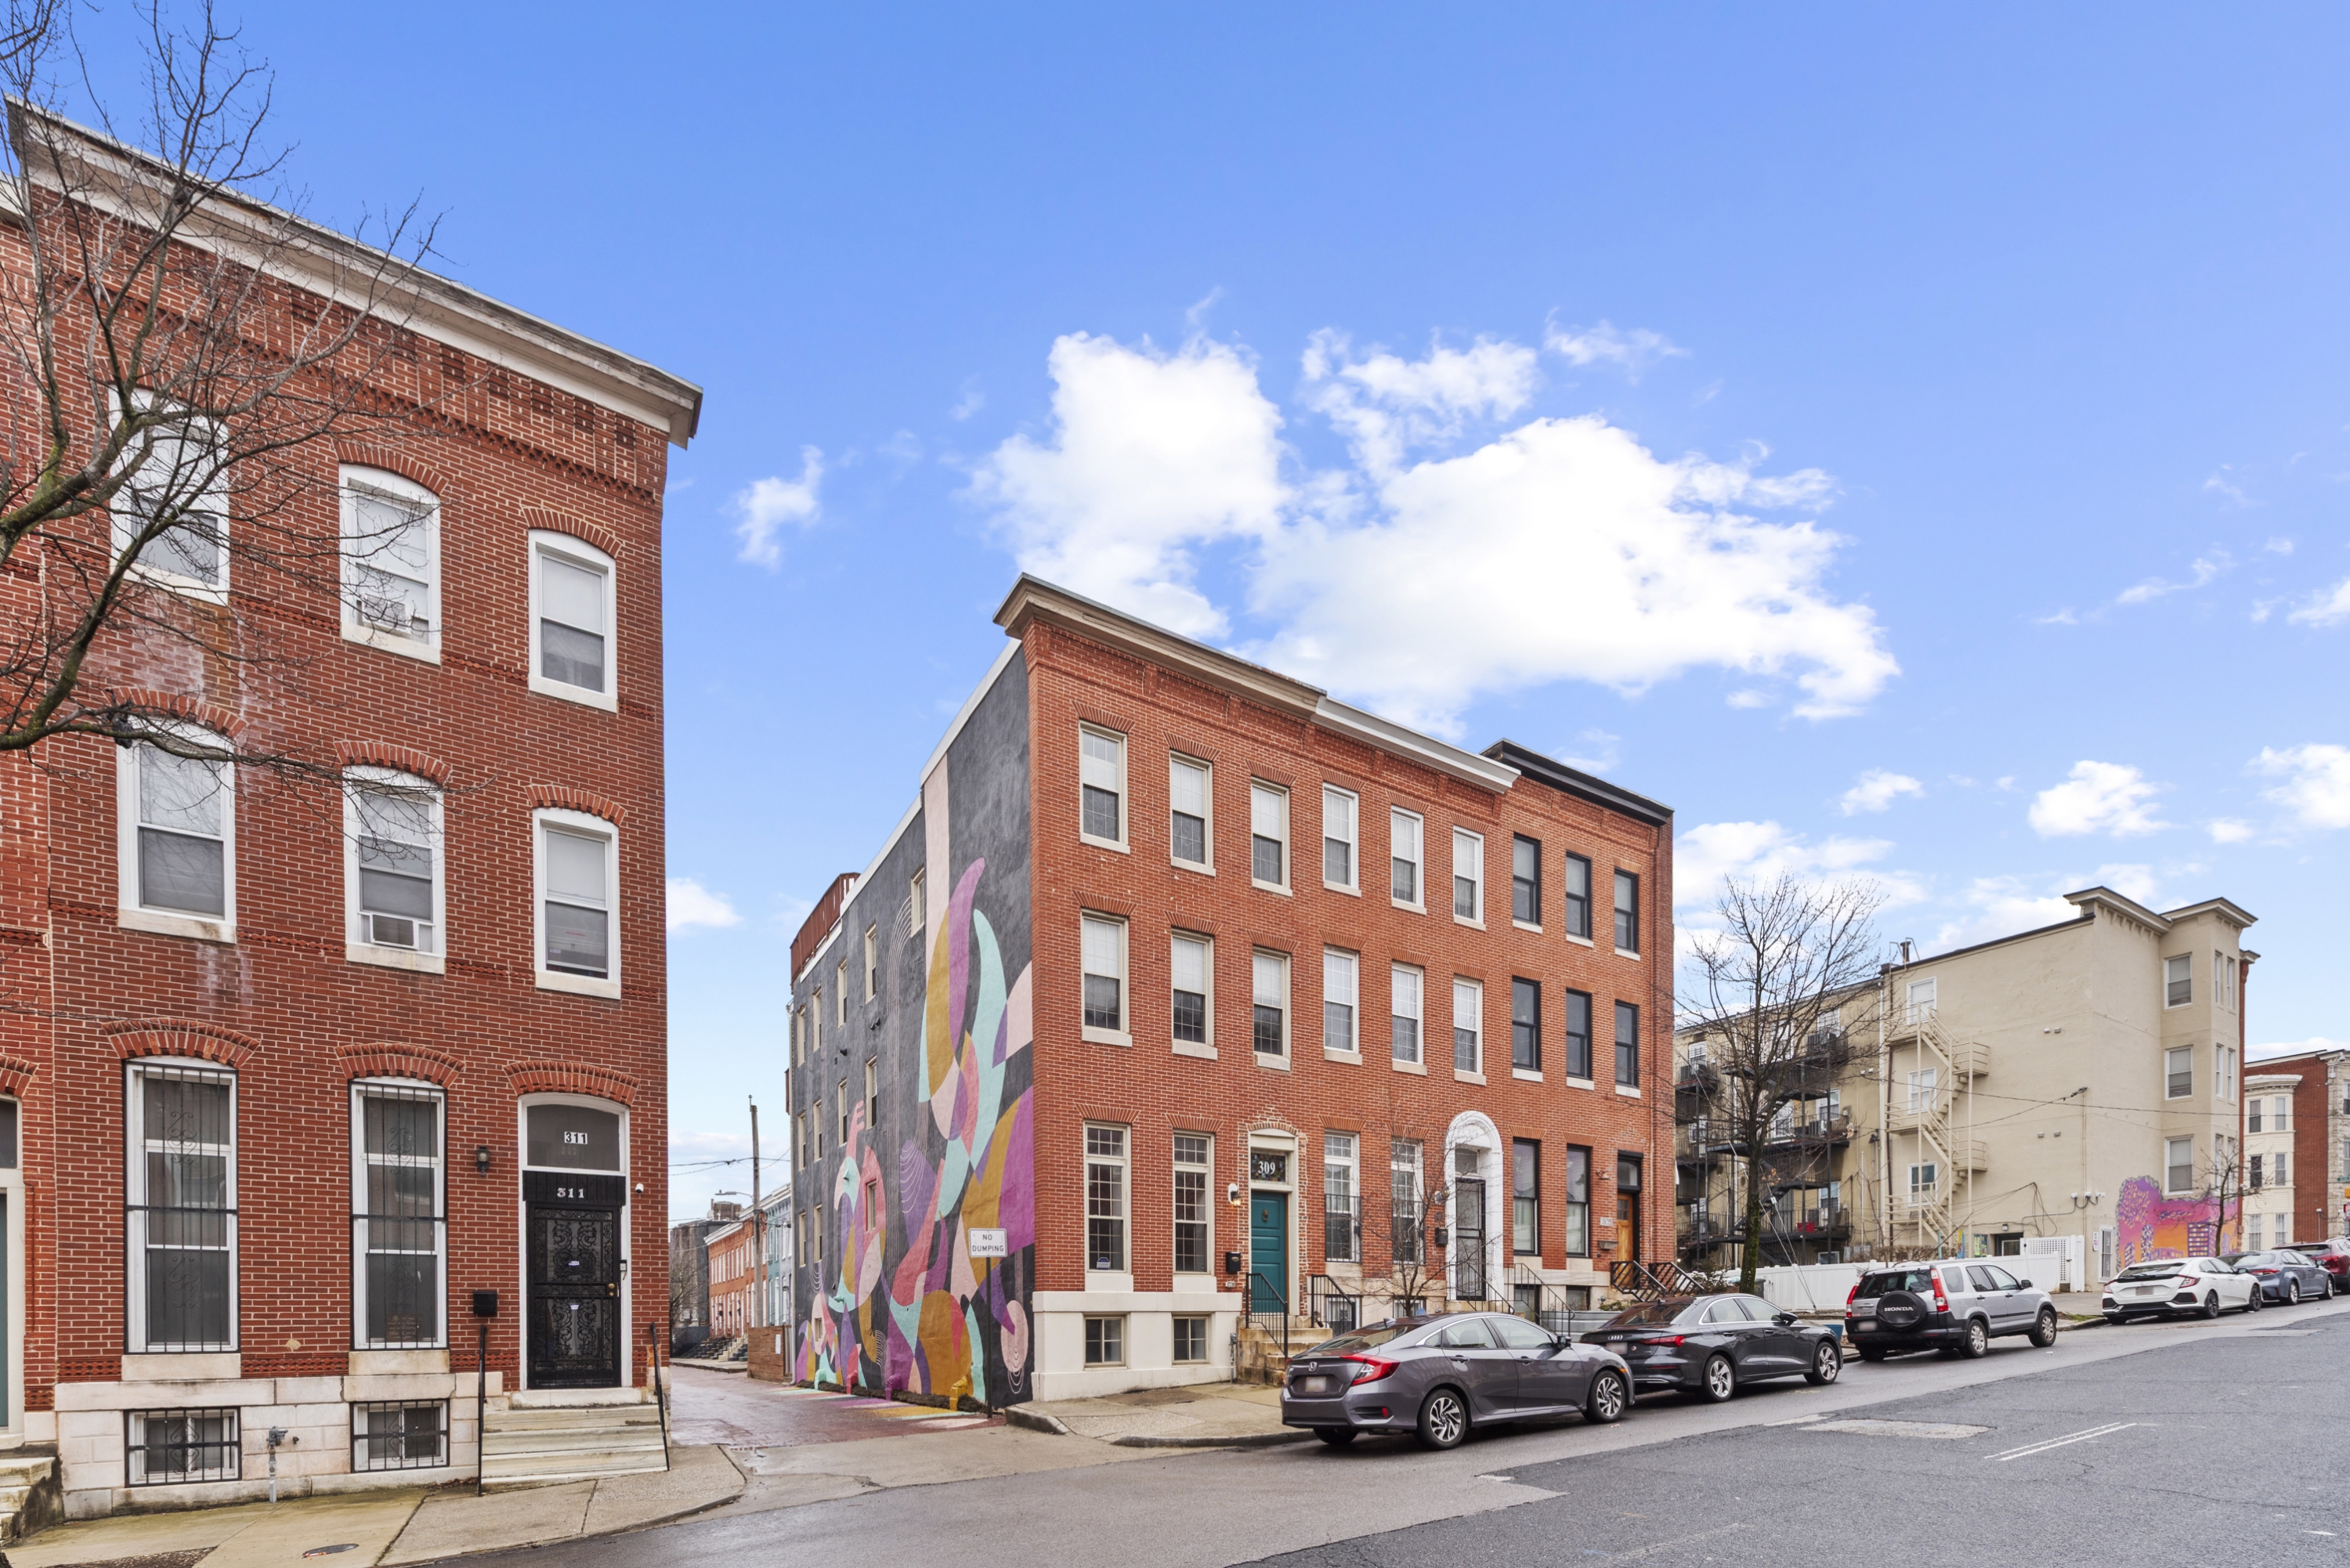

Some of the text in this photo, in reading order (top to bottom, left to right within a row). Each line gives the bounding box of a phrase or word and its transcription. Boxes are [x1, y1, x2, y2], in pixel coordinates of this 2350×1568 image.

[566, 1133, 586, 1143] 311
[1258, 1161, 1275, 1174] 309
[557, 1187, 584, 1198] 311
